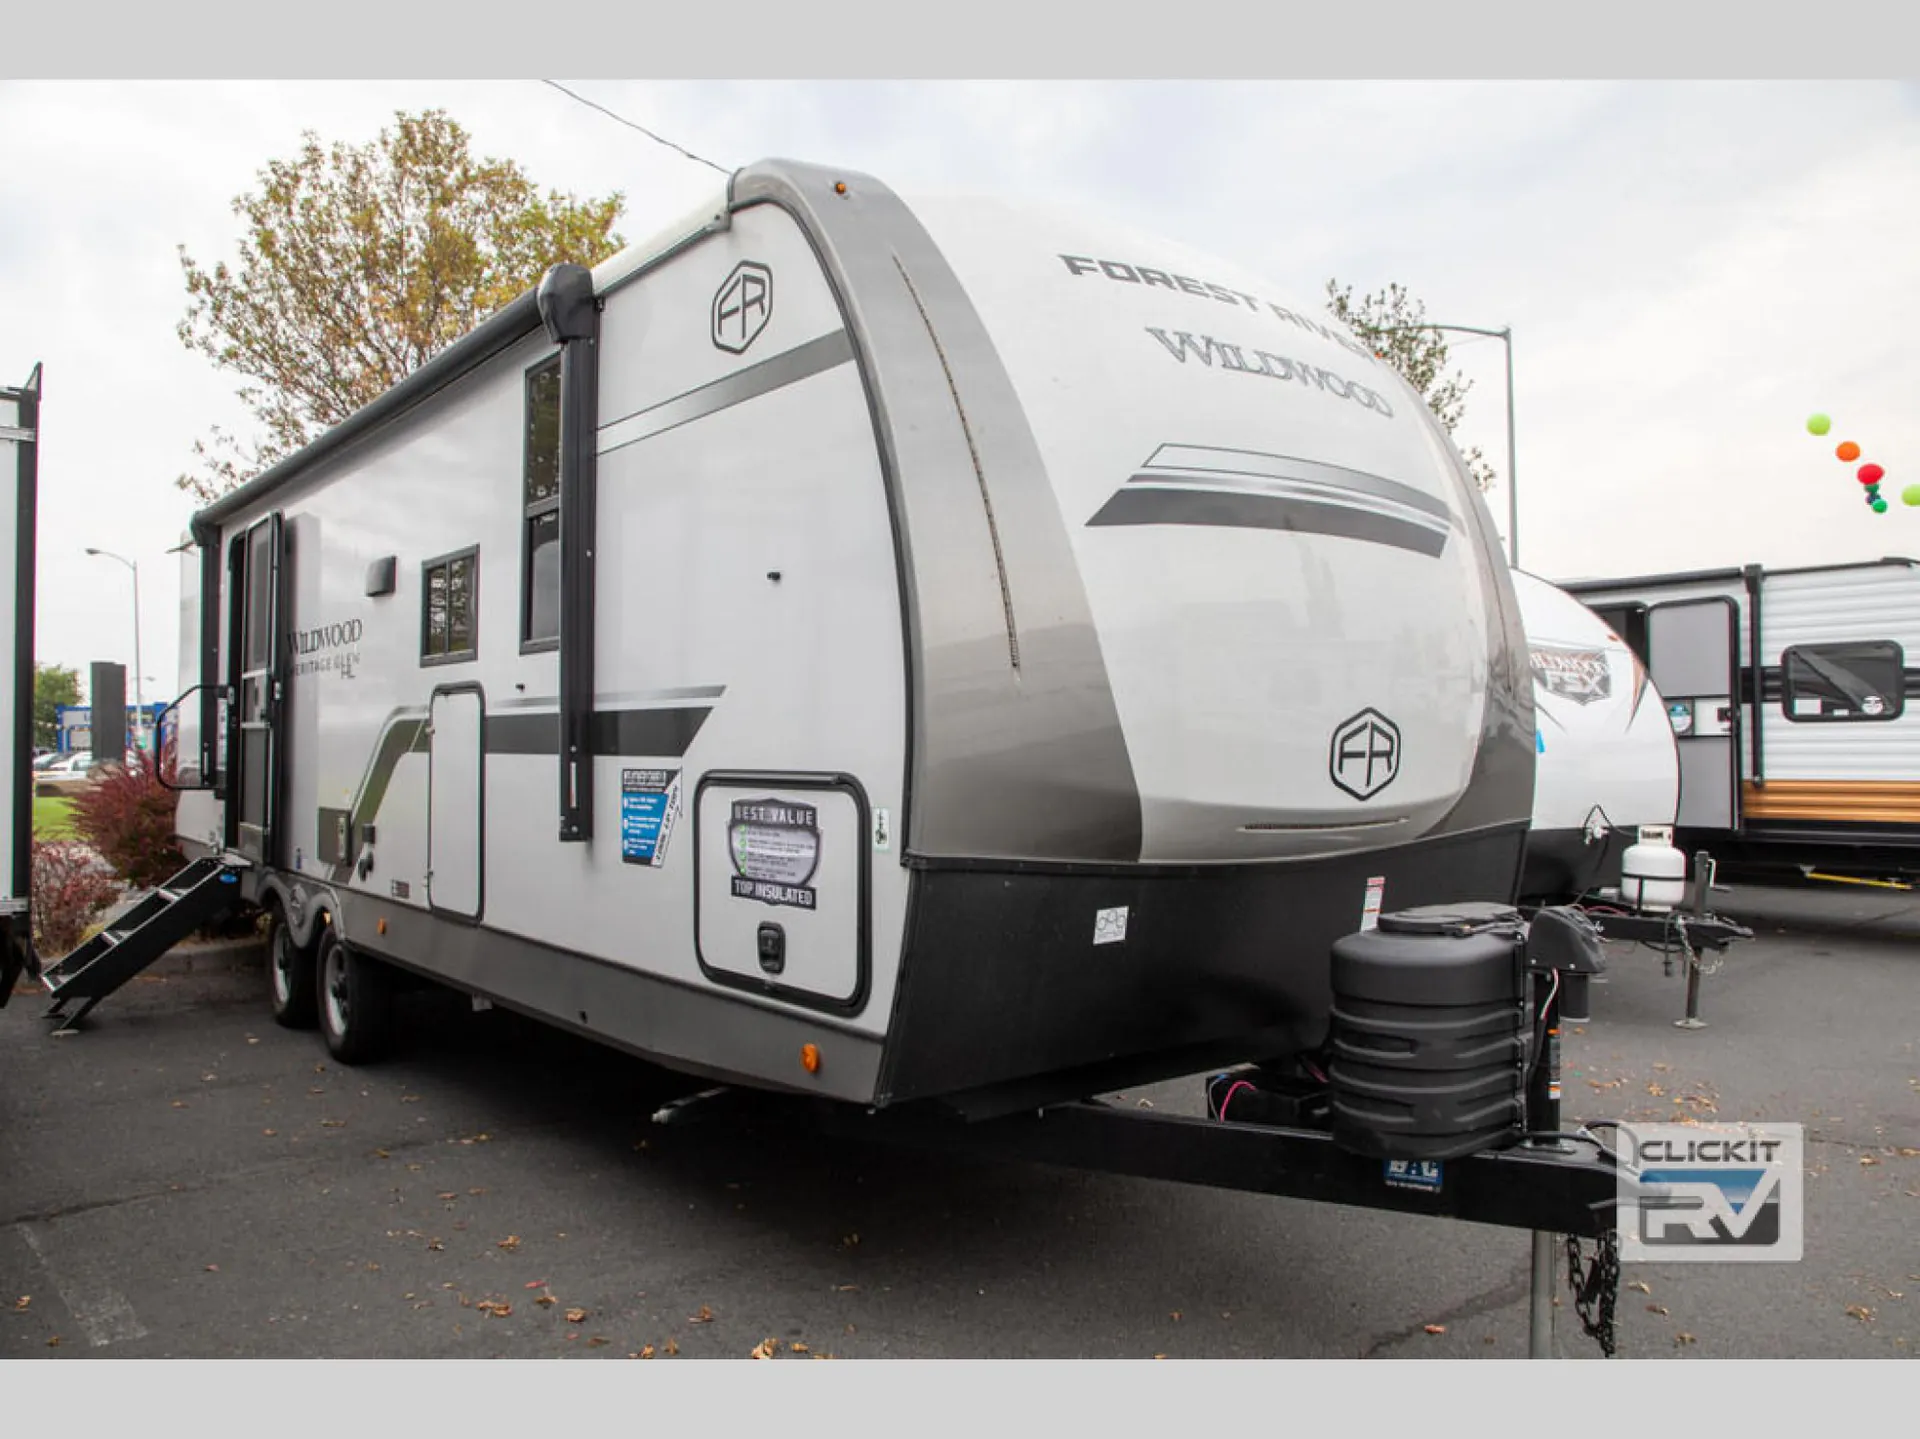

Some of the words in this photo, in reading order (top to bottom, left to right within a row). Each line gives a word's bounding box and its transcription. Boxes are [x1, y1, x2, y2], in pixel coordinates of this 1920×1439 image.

[1057, 253, 1260, 312] FOREST
[1145, 325, 1395, 419] WILDWOOD
[286, 618, 363, 655] WILDWOOD
[770, 807, 814, 826] VALUE
[734, 879, 754, 897] TOP
[755, 882, 813, 906] INSULATED
